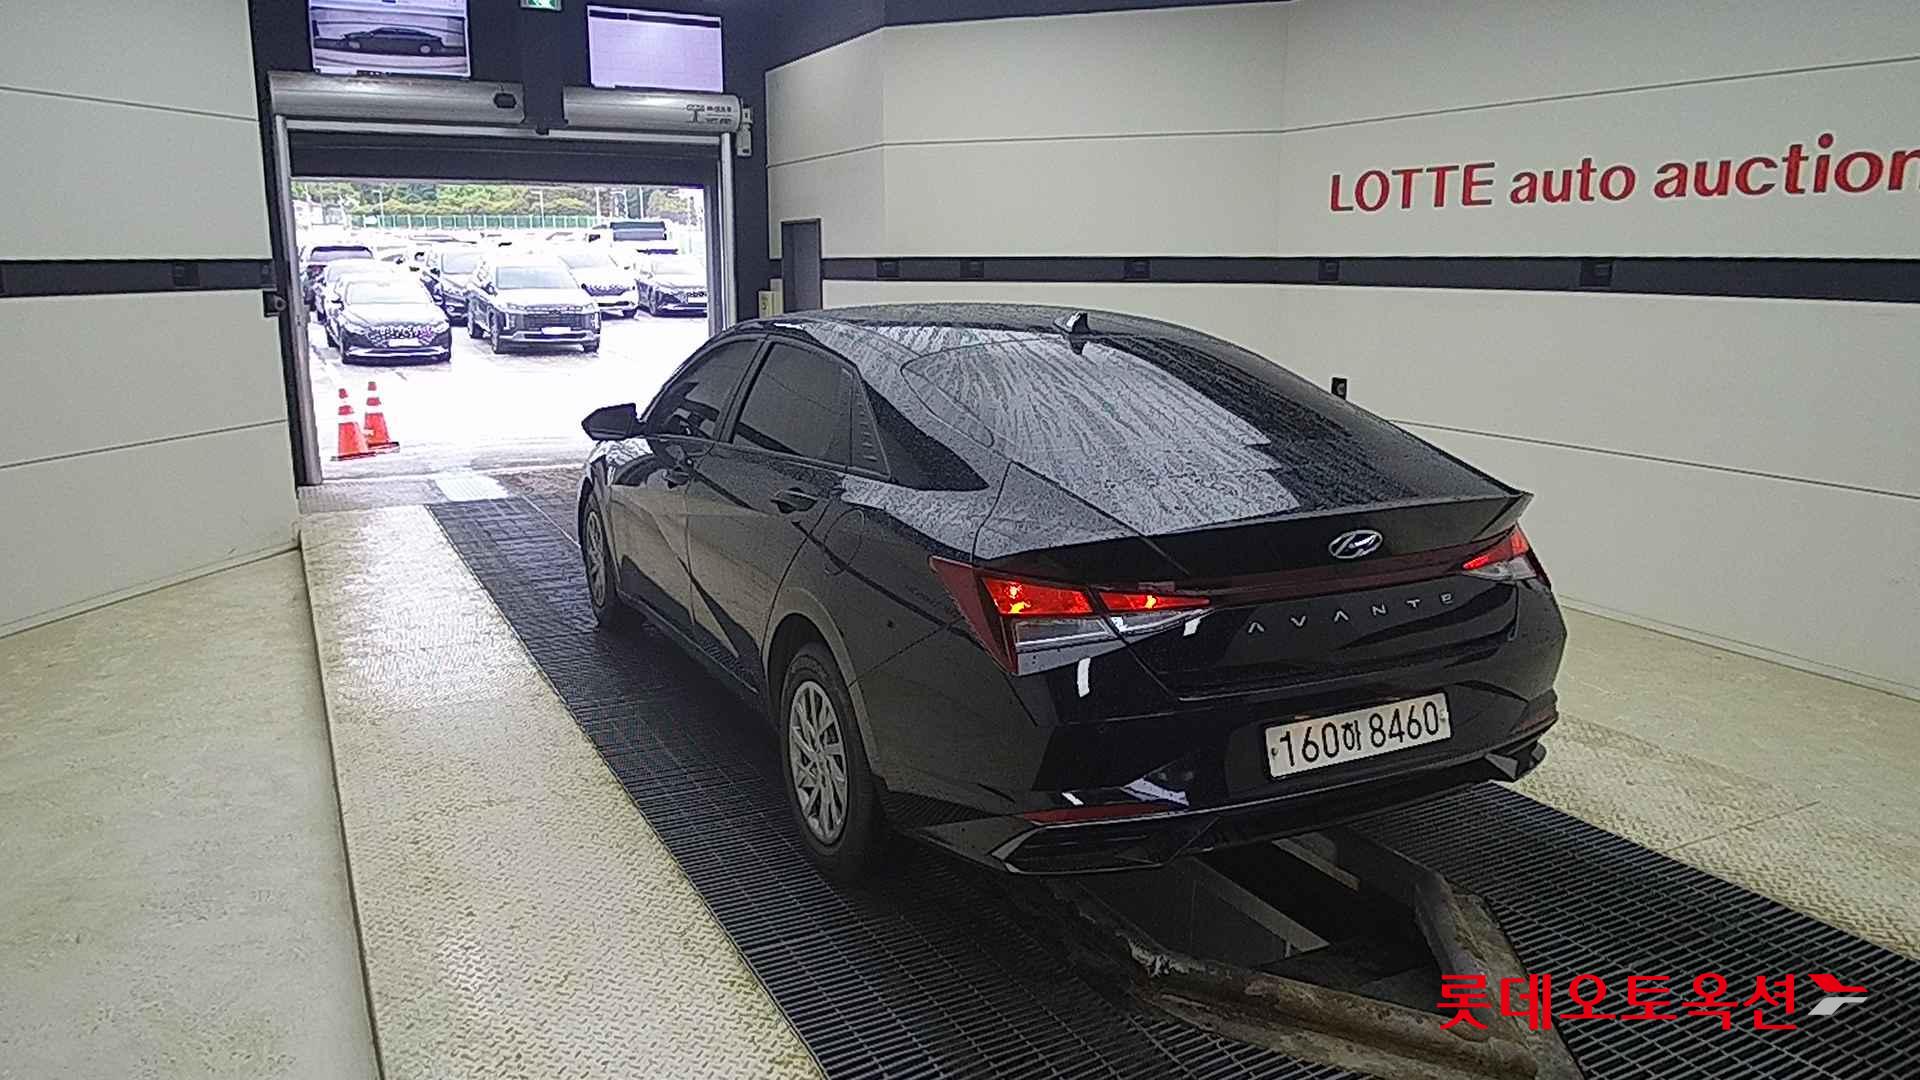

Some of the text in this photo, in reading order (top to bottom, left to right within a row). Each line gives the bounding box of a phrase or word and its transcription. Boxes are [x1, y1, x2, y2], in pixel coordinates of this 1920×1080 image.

[1330, 162, 1496, 212] LOTTE
[1510, 157, 1636, 203] auto
[1248, 592, 1453, 634] AVANTE
